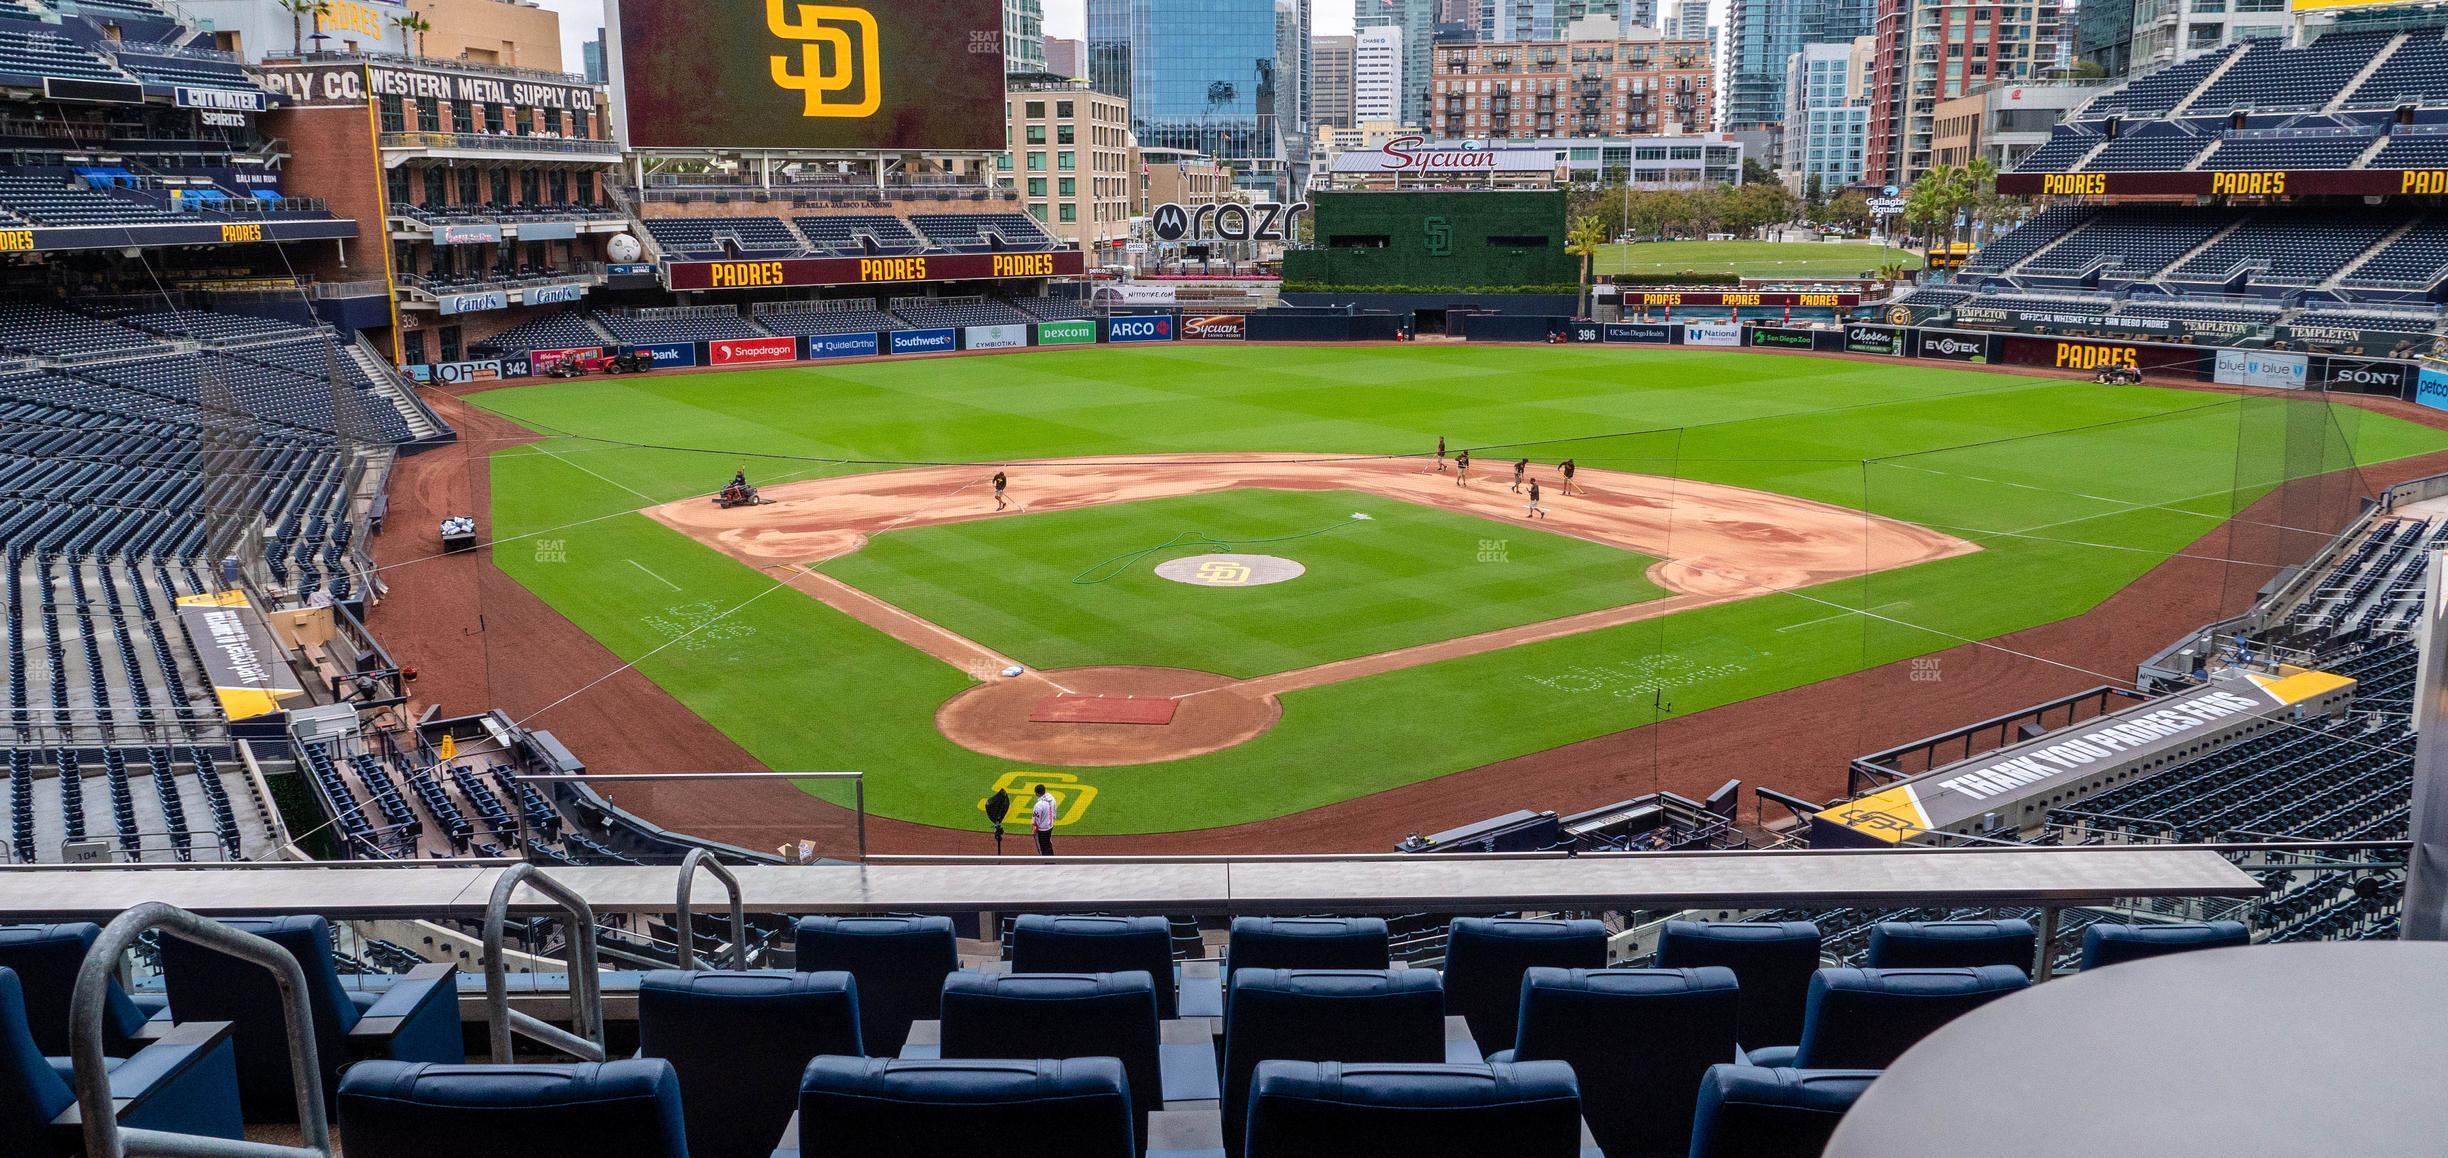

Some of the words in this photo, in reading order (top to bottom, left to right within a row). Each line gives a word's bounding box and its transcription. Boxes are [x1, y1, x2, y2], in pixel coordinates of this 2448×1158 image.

[317, 2, 381, 40] PADRES
[323, 71, 368, 100] CO.
[369, 68, 451, 99] WESTERN
[458, 78, 510, 104] METAL
[513, 83, 567, 109] SUPPLY
[572, 89, 595, 111] CO.
[187, 90, 257, 109] CUTWATER
[202, 111, 245, 127] SPIRITS
[1381, 136, 1498, 177] Sycuan
[2043, 174, 2106, 194] PADRES
[2213, 172, 2285, 195] PADRES
[2401, 170, 2448, 194] PAD
[1872, 205, 1904, 215] Square
[1192, 202, 1308, 241] razr
[222, 224, 261, 241] PADRES
[861, 258, 926, 281] PADRES
[993, 254, 1053, 276] PADRES
[712, 262, 783, 287] PADRES
[535, 287, 572, 304] Canel's
[1644, 294, 1681, 305] PADRES
[1722, 295, 1760, 305] PADRES
[1800, 295, 1838, 306] PADRES
[453, 294, 497, 313] Canel's
[402, 314, 419, 328] 336
[1956, 309, 2007, 320] TEMPLETON
[2053, 314, 2087, 324] WHISKEY
[2105, 317, 2119, 326] SAN
[2120, 318, 2140, 327] DIEGO
[2141, 319, 2169, 328] PADRES
[1111, 322, 1154, 337] ARCO
[1185, 317, 1239, 338] Sycuan
[1578, 329, 1596, 340] 396
[1704, 330, 1737, 338] National
[1851, 328, 1890, 342] Chosen
[2183, 321, 2247, 334] TEMPLETON
[2290, 327, 2360, 341] TEMPLETON
[826, 341, 875, 351] QuidelOrtho
[894, 336, 945, 348] Southwest
[1779, 336, 1798, 344] Diego
[1925, 338, 1980, 354] EVOTEK
[735, 346, 791, 357] Snapdragon
[2056, 343, 2137, 370] PADRES
[506, 361, 528, 376] 342
[2219, 360, 2246, 371] blue
[2262, 363, 2290, 375] blue
[2338, 370, 2400, 385] SONY
[1938, 753, 2063, 800] THANK
[2033, 739, 2113, 769] YOU
[2082, 708, 2204, 752] PADRES
[2175, 691, 2260, 721] FANS
[78, 851, 97, 860] 104
